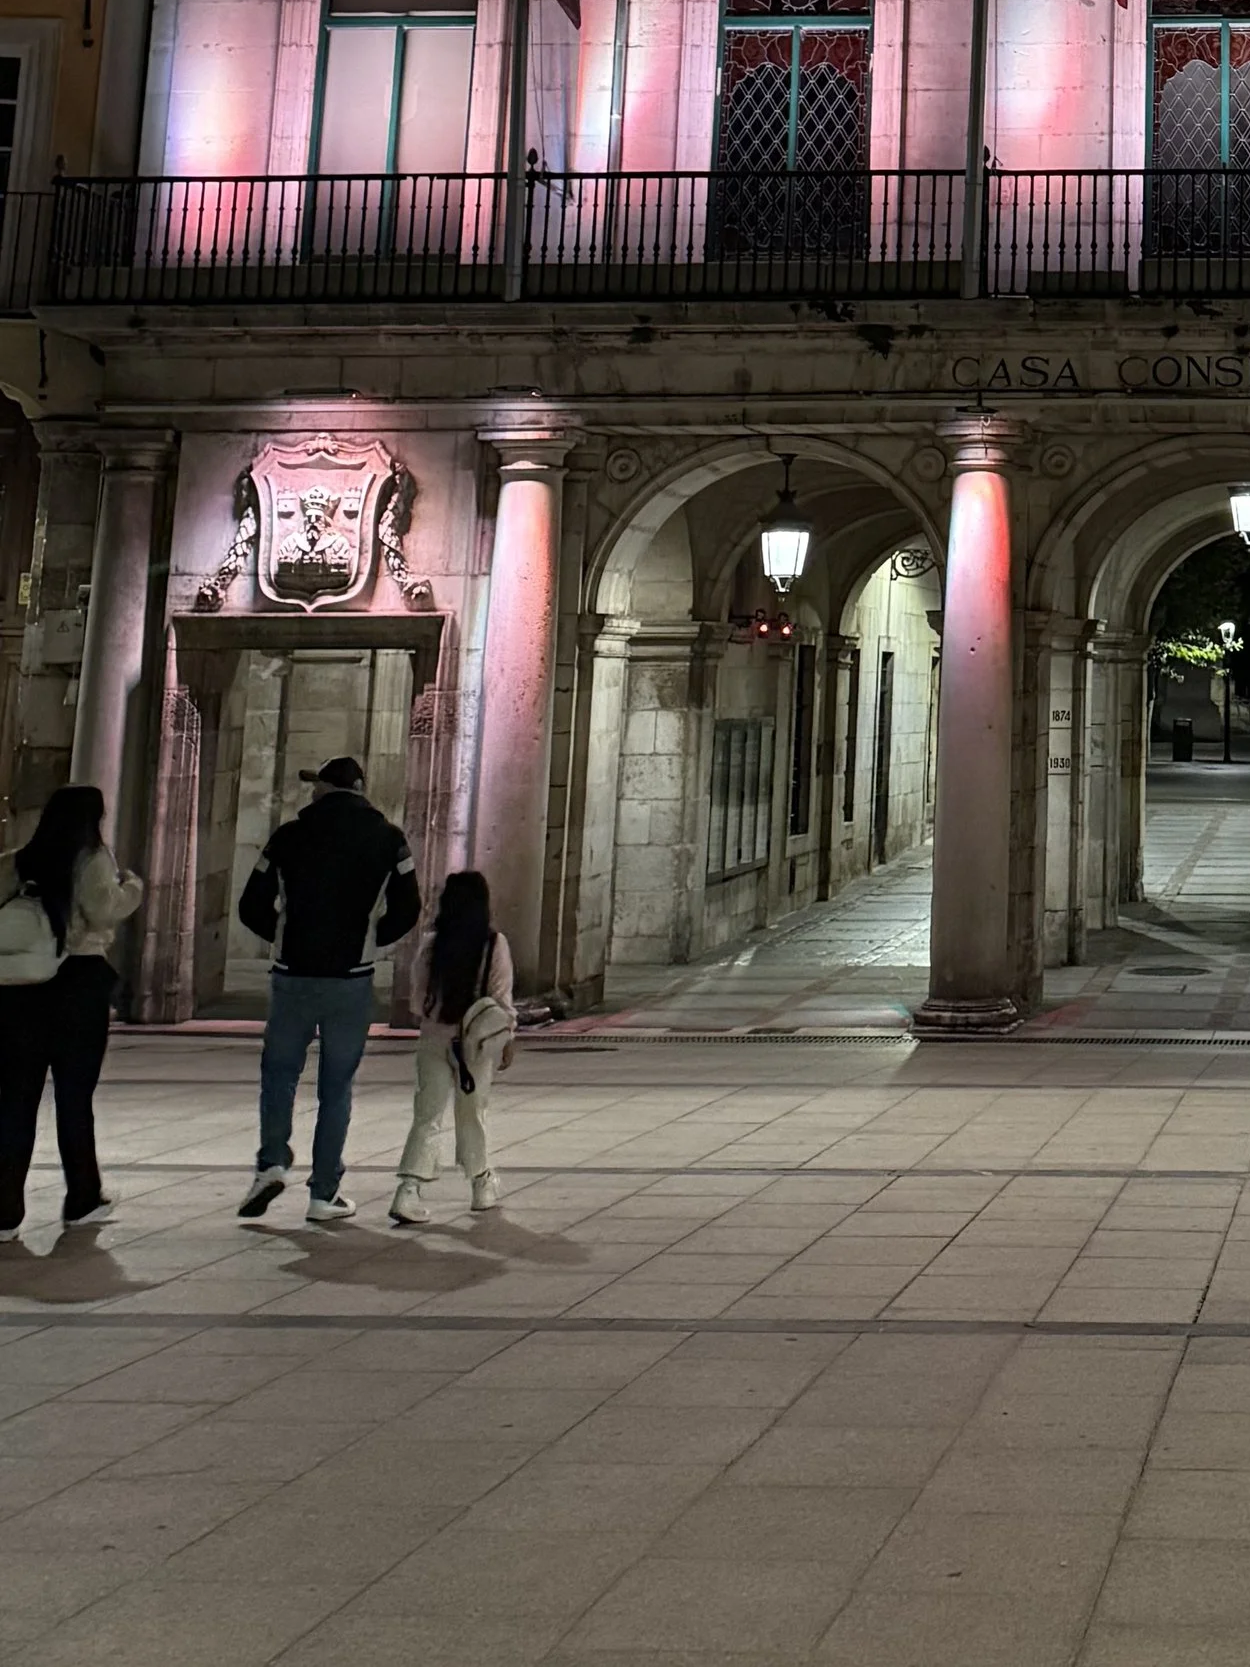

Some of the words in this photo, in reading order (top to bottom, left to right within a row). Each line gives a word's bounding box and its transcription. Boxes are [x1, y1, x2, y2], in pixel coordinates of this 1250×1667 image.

[951, 356, 1081, 388] CASA
[1052, 710, 1070, 721] 1874
[1050, 758, 1070, 768] 1930
